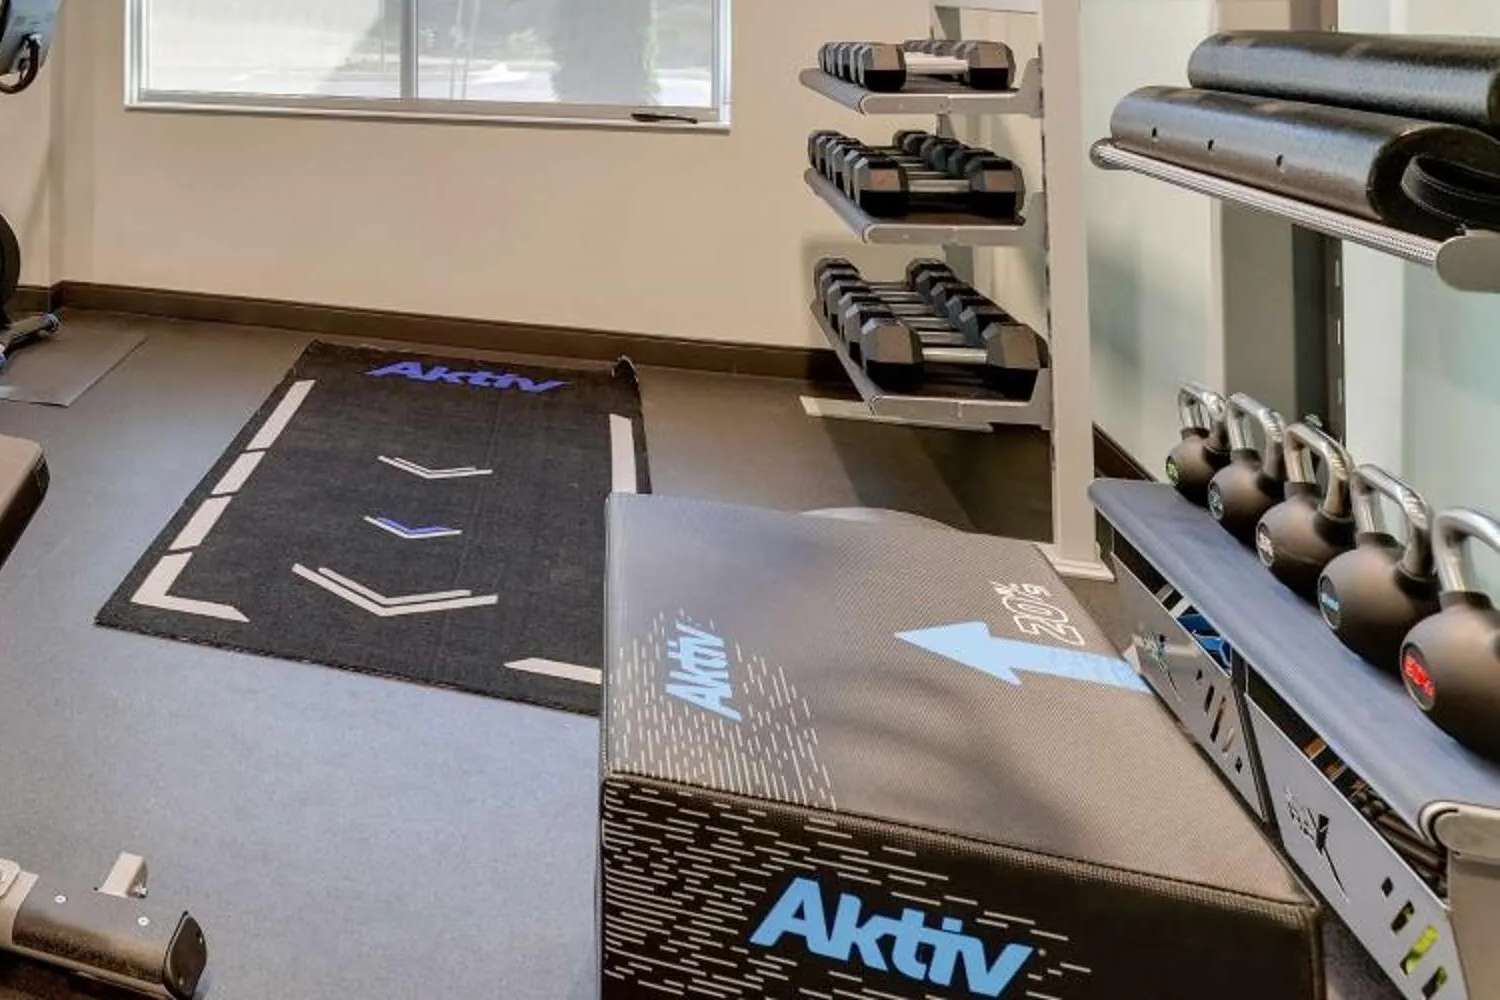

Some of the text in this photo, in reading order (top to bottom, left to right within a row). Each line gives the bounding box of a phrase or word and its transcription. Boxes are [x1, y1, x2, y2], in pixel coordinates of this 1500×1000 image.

[364, 361, 573, 392] Aktiv
[665, 620, 742, 721] Aktiv
[750, 877, 1034, 997] Aktiv
